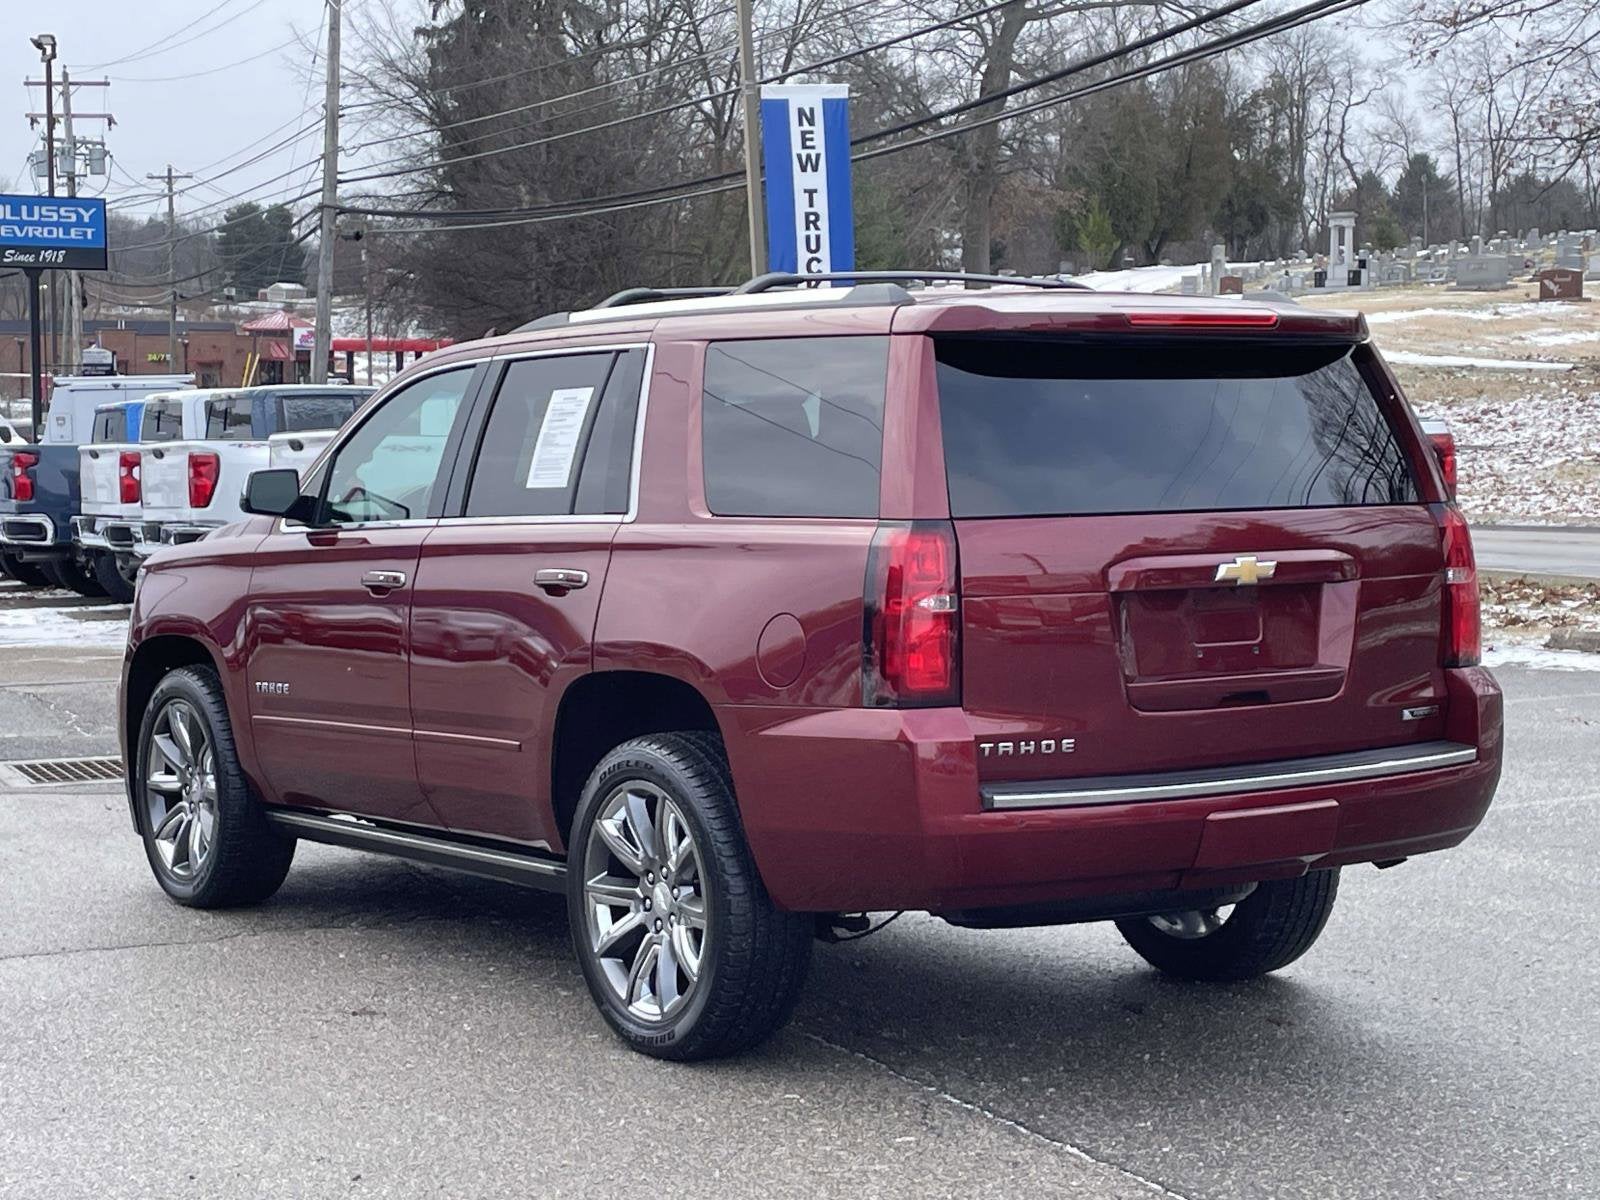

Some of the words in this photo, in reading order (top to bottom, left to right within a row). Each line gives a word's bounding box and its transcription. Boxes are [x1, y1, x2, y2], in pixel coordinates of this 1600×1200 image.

[796, 106, 822, 173] NEW
[0, 203, 97, 223] LUSSY
[0, 224, 97, 240] EVROLET
[3, 249, 37, 263] Since
[38, 249, 66, 264] 1918
[255, 681, 290, 695] TAHOE
[979, 738, 1076, 757] TAHOE
